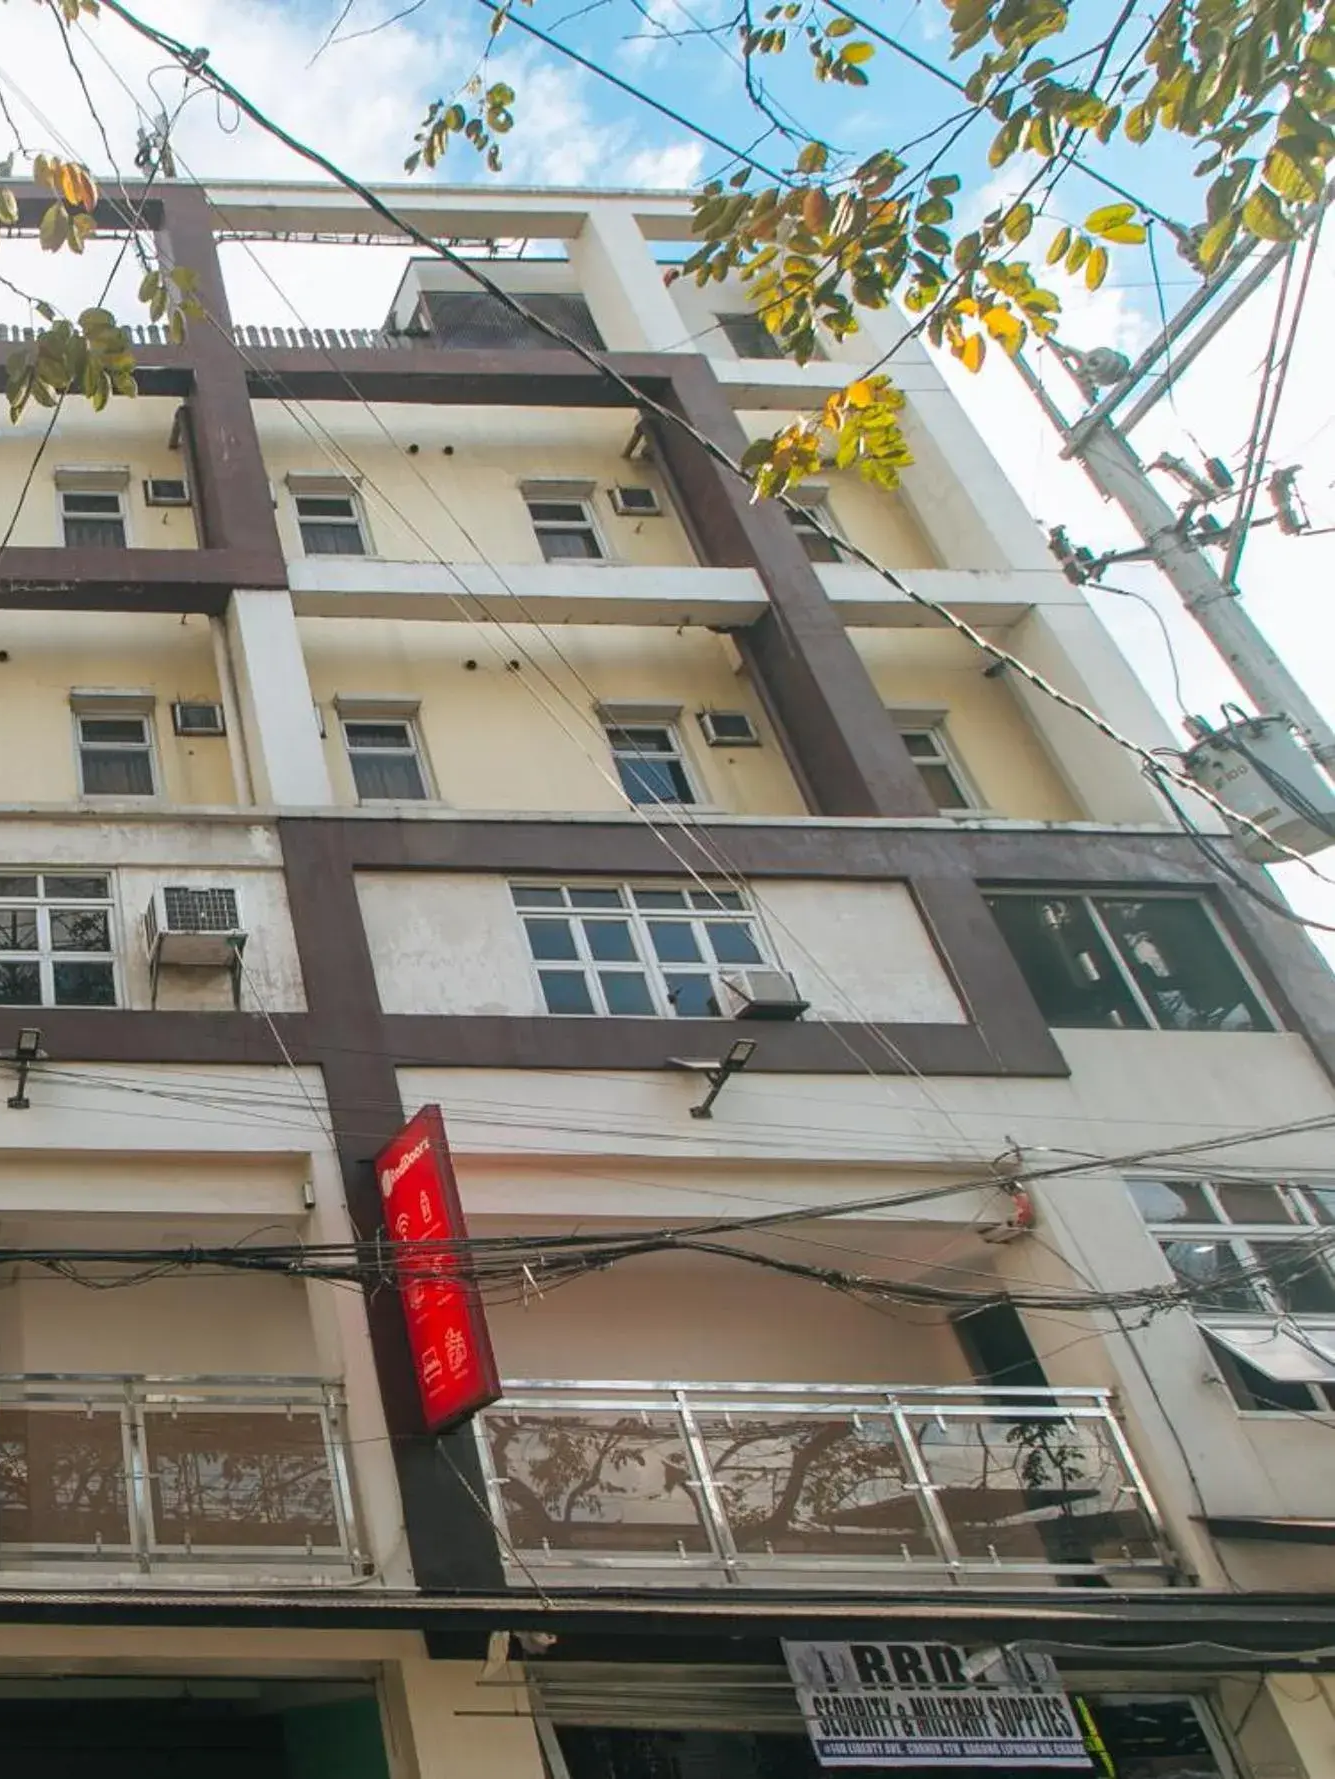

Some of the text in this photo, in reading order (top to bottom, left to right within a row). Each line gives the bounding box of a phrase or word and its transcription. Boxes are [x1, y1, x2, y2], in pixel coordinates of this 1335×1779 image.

[812, 1697, 1074, 1737] SECURITY & MILITARY SUPPLIES
